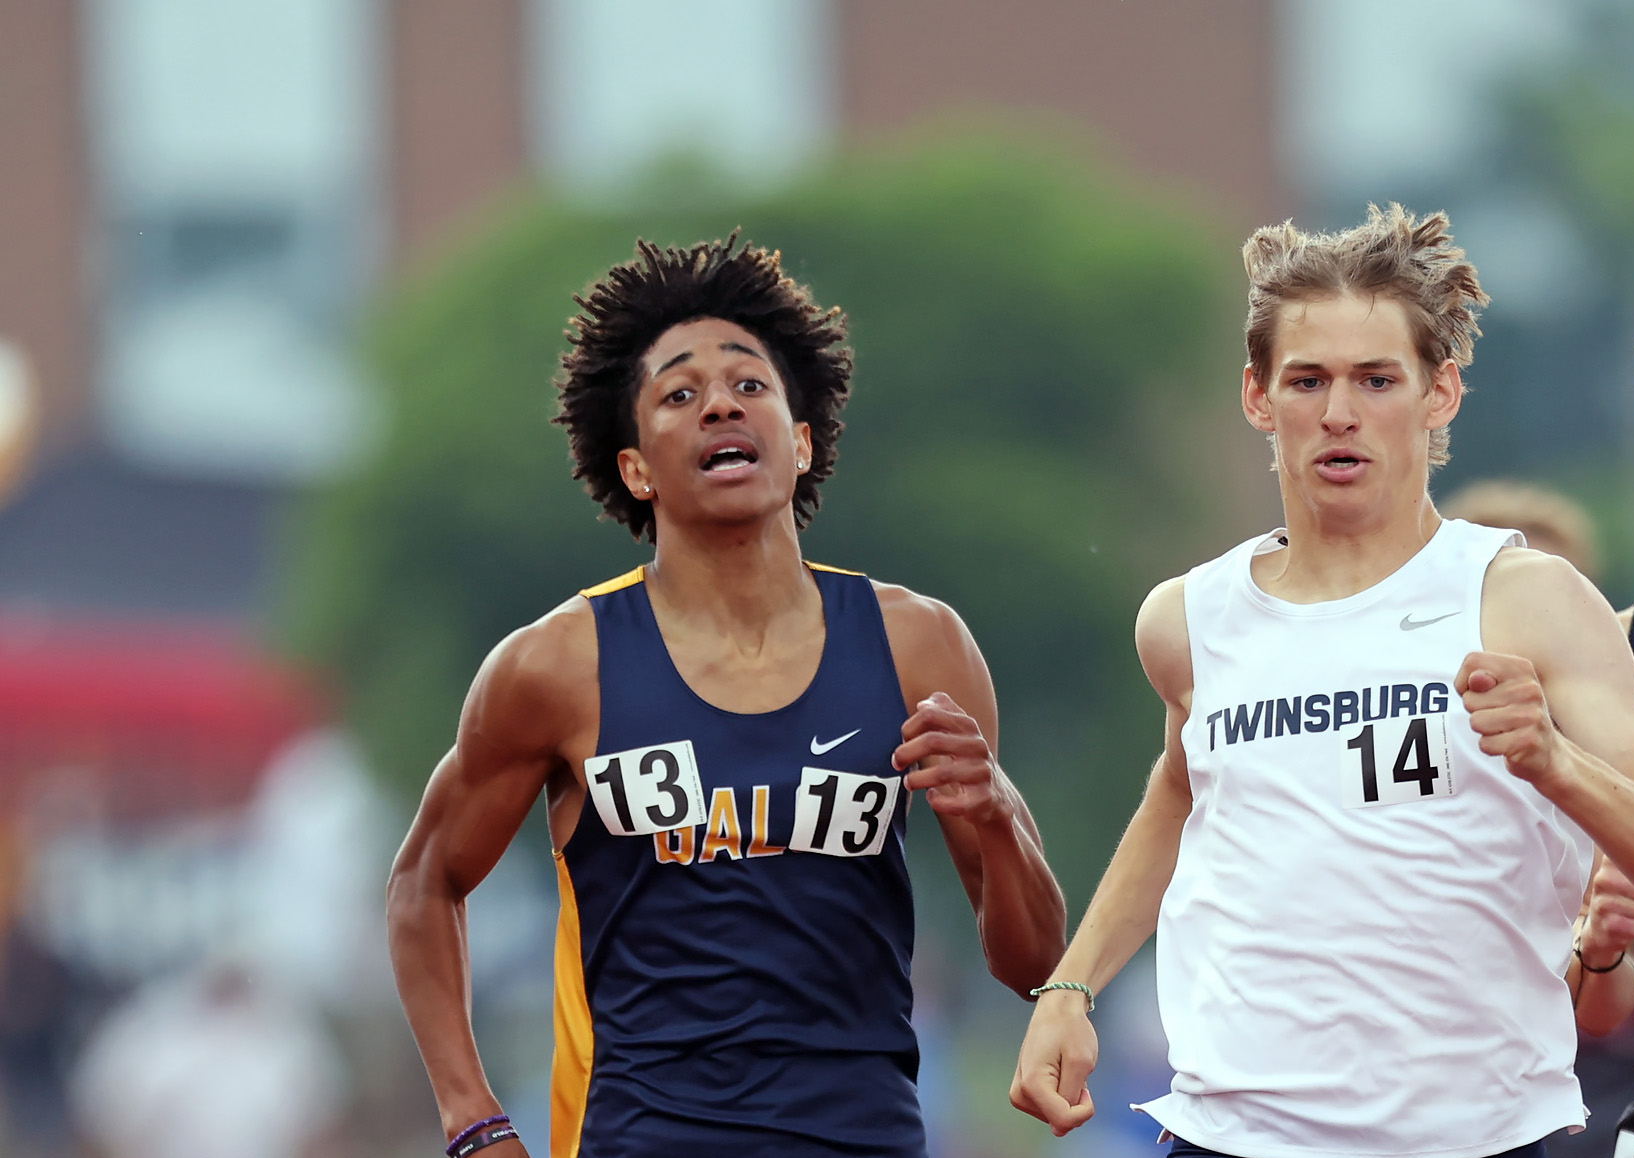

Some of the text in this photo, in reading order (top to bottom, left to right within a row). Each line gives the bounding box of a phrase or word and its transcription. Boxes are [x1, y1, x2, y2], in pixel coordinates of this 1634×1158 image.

[1206, 682, 1449, 752] TWINSBURG
[594, 749, 690, 833] 13
[1347, 718, 1439, 803] 14
[808, 774, 888, 854] 13
